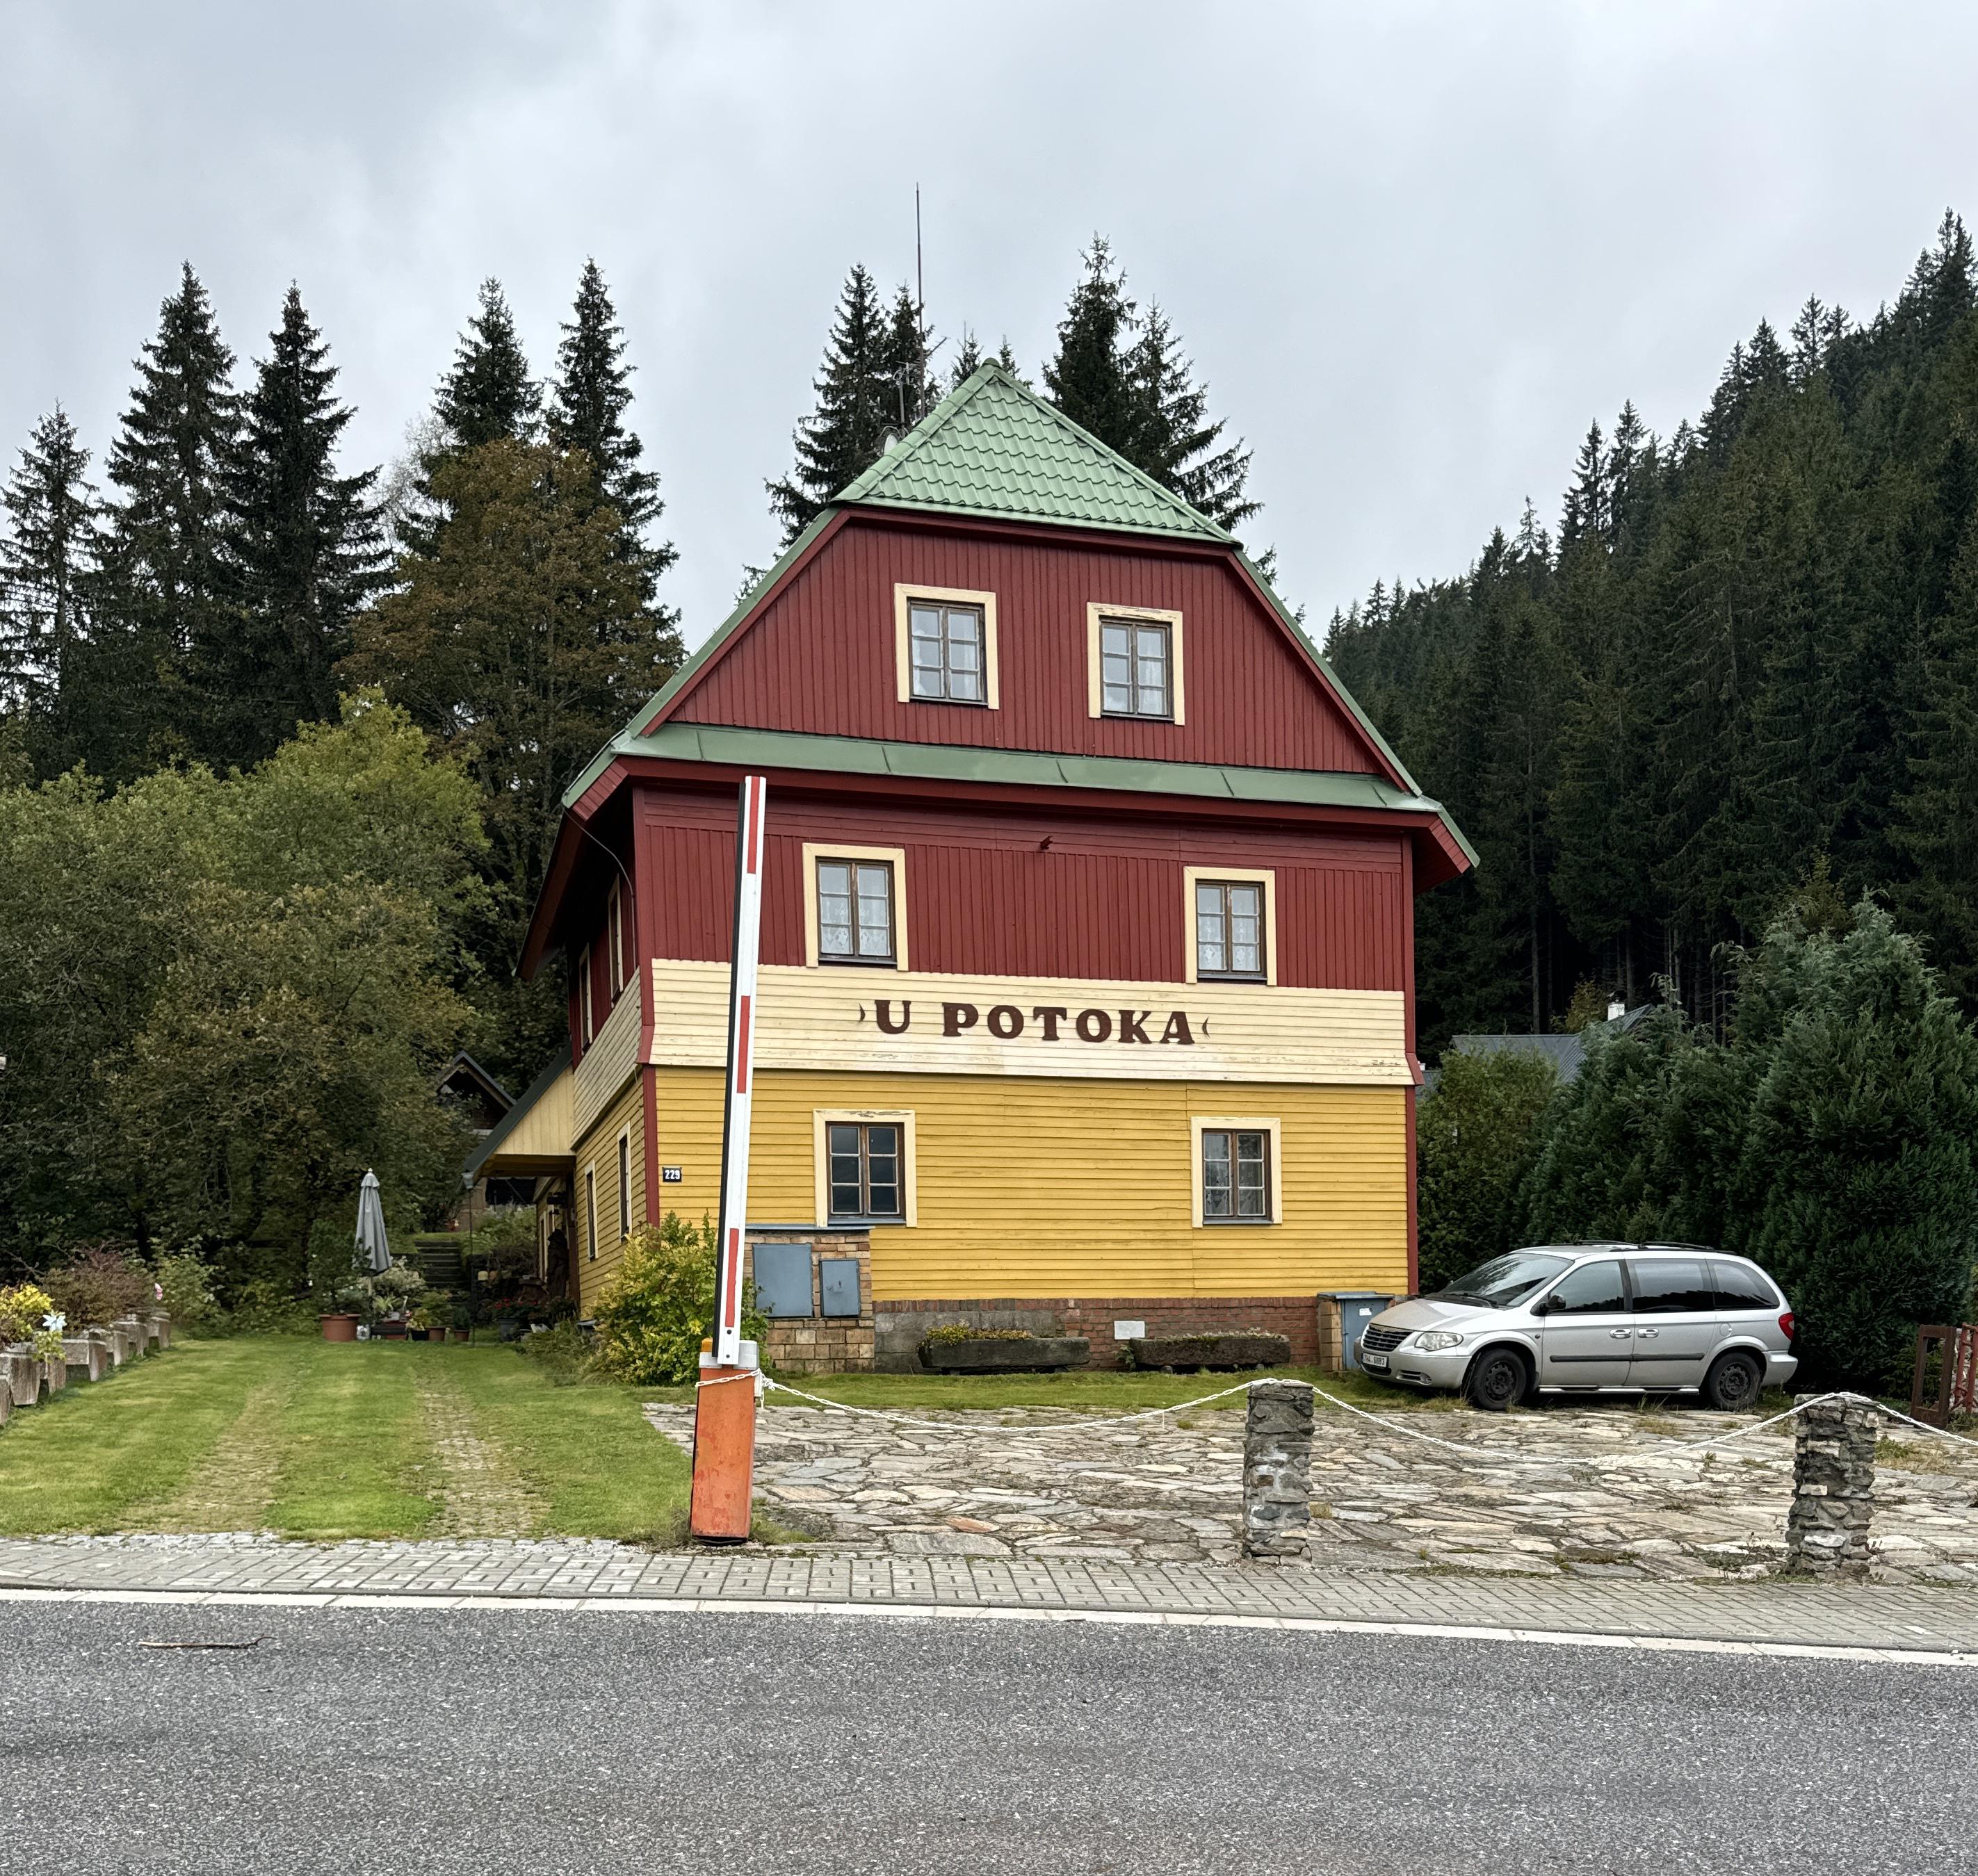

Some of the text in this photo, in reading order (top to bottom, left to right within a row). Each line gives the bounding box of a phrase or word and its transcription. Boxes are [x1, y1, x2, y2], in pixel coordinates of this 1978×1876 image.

[874, 999, 1195, 1045] U POTOKA
[665, 1170, 680, 1179] 229
